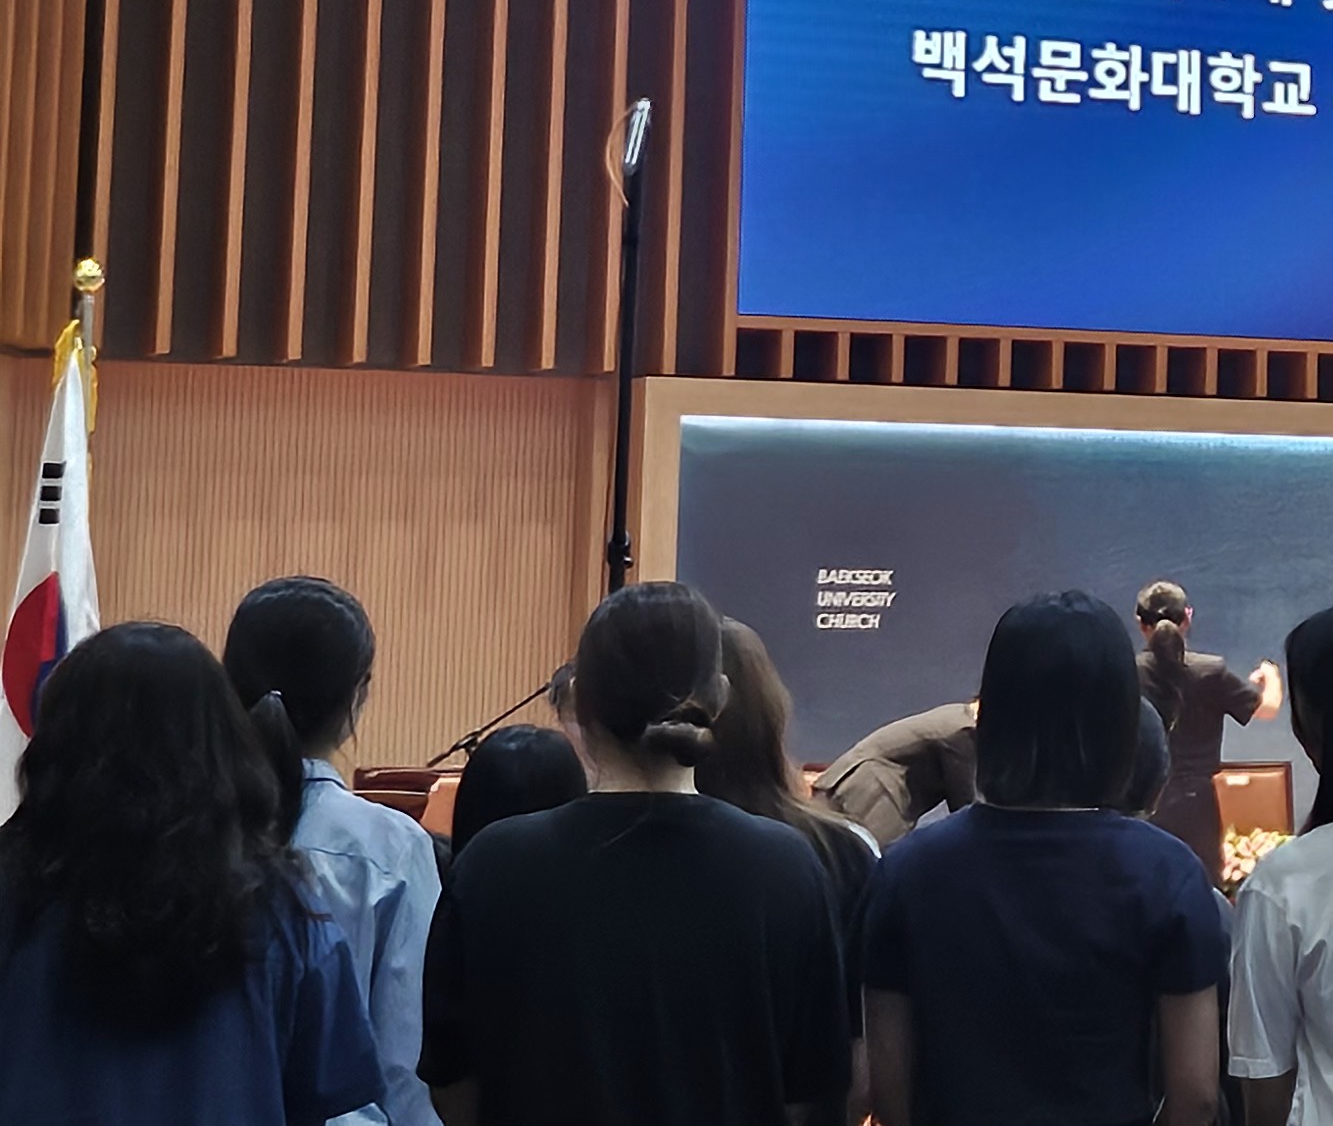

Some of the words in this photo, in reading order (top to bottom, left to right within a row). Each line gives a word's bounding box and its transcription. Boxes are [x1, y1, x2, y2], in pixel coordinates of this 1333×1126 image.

[913, 30, 1316, 118] 백석문화대학교
[817, 590, 897, 607] UNIVERSITY
[816, 613, 880, 629] CHURCH
